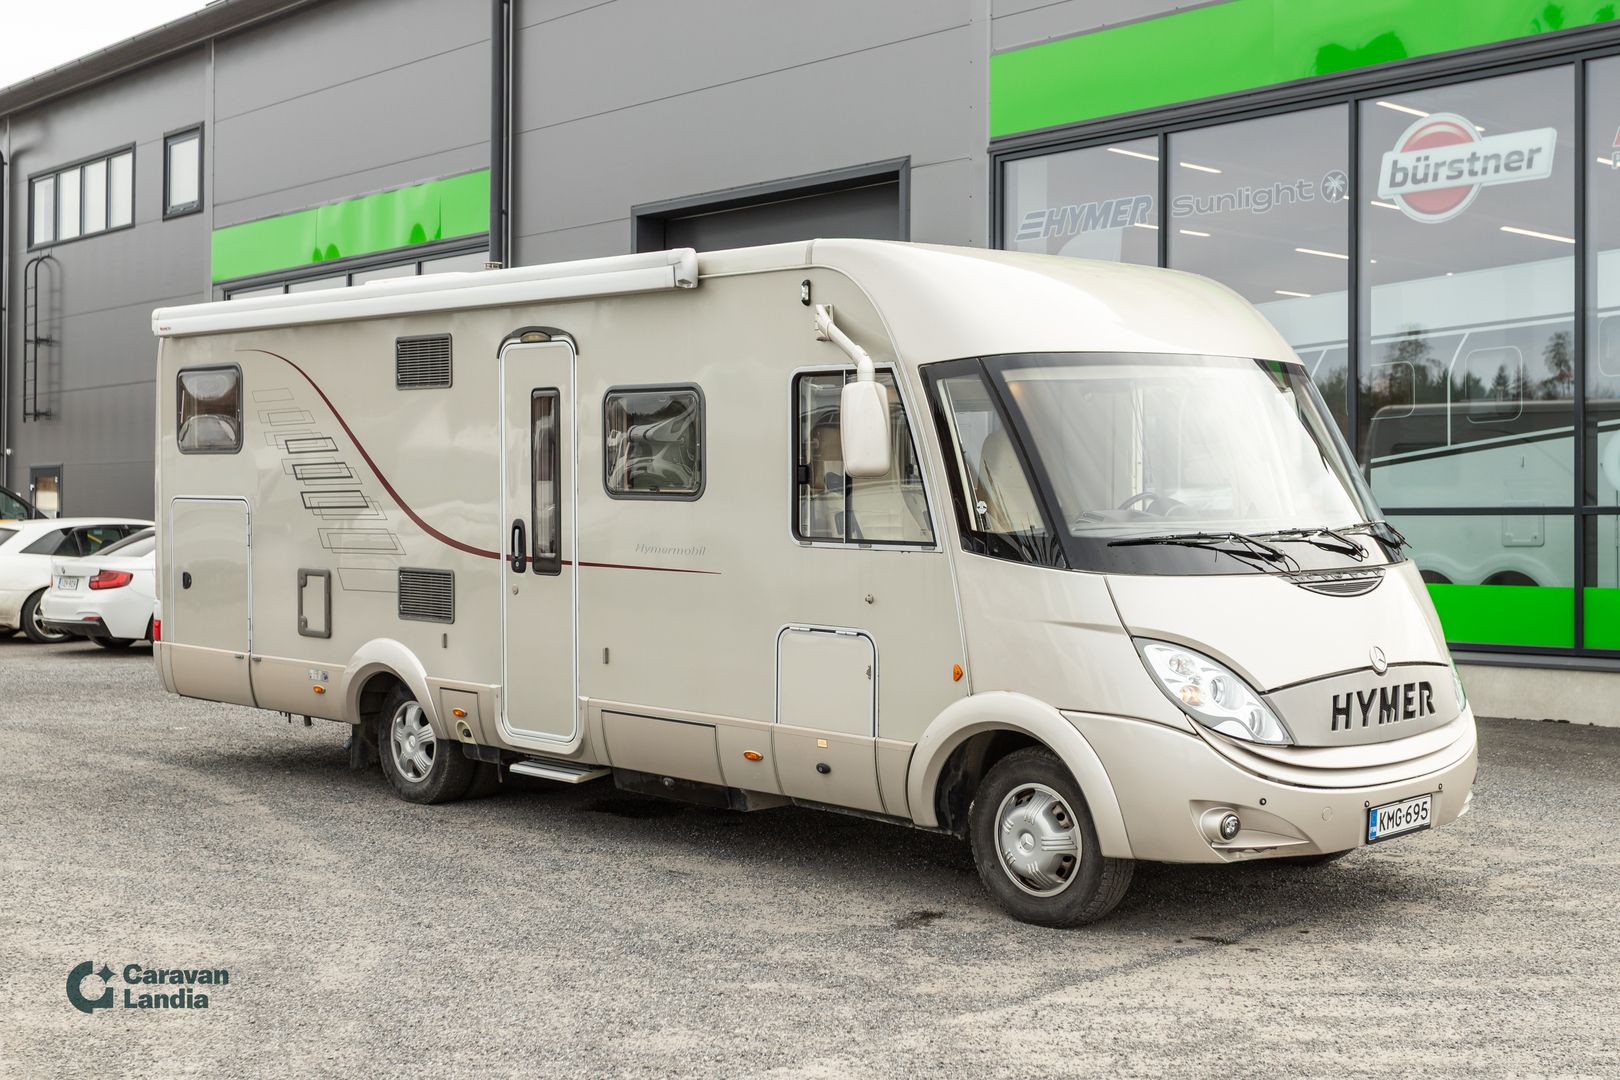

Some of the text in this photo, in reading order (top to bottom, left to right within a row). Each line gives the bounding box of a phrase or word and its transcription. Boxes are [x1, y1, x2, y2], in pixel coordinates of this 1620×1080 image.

[1389, 147, 1542, 188] bürstner
[1042, 195, 1153, 238] HYMER
[1172, 180, 1314, 217] Sunlight
[634, 543, 706, 557] Hymermobil
[1331, 681, 1436, 731] HYMER
[1379, 801, 1428, 832] KMG-695
